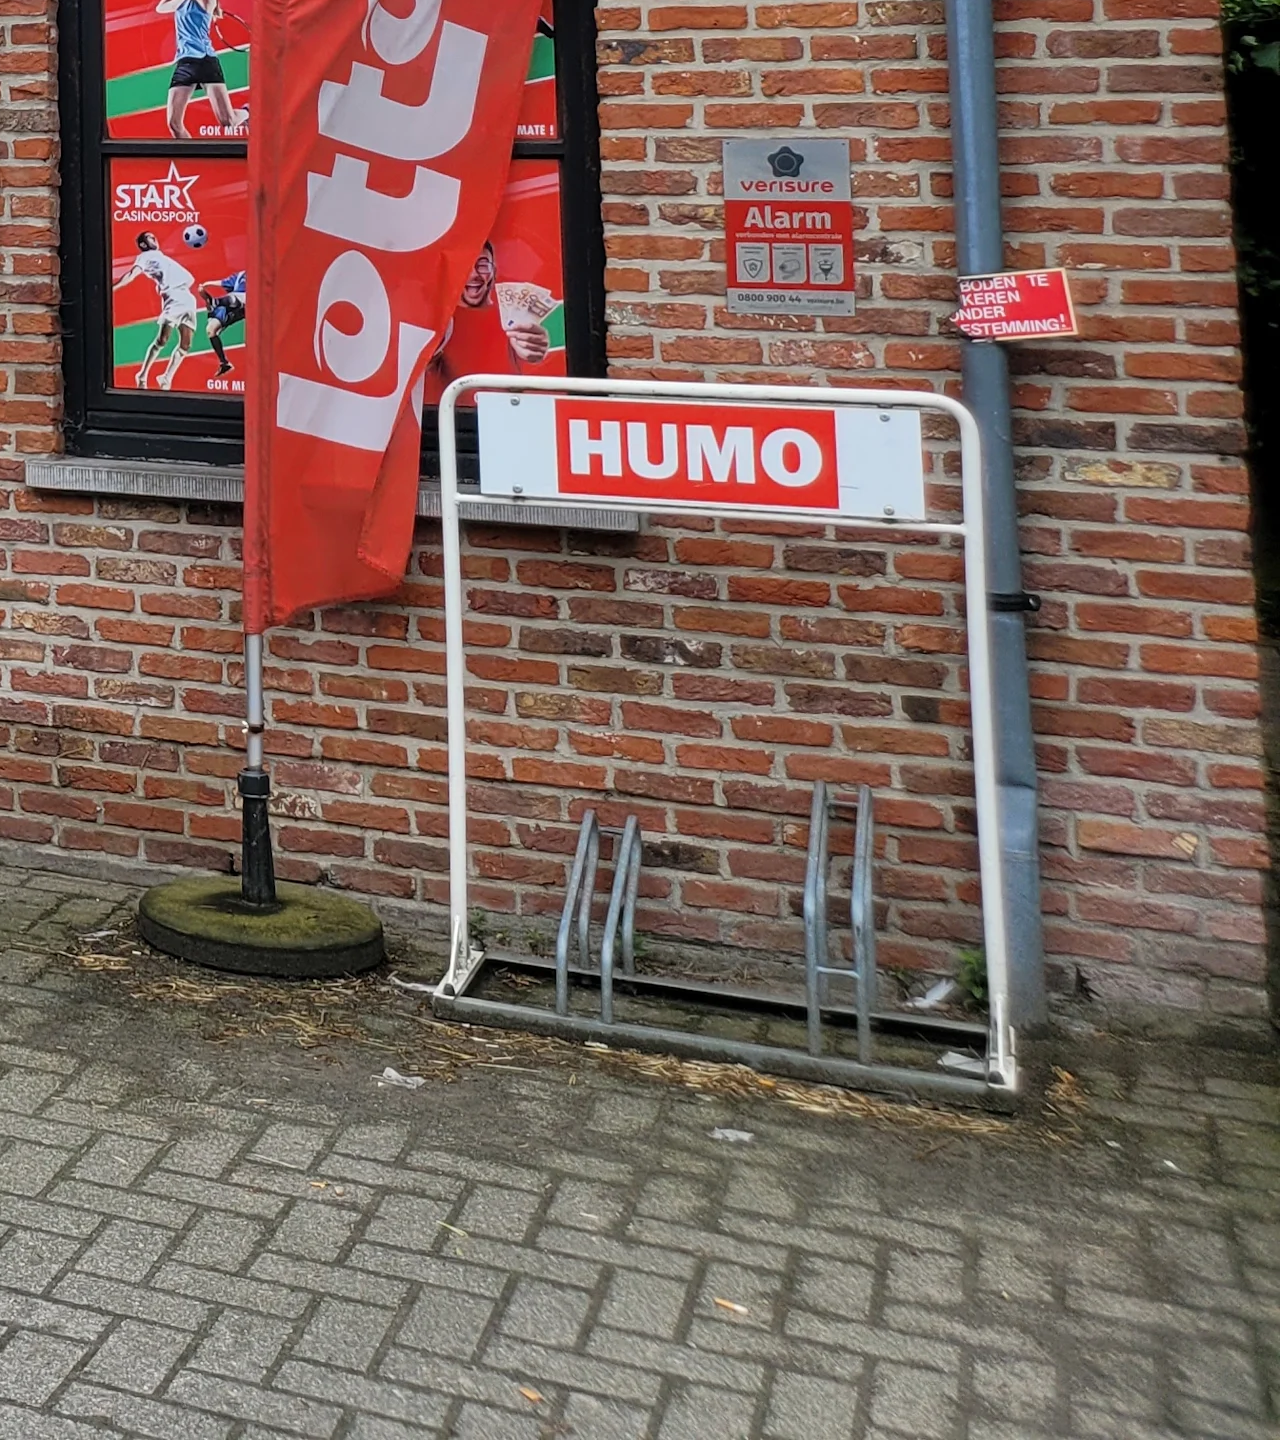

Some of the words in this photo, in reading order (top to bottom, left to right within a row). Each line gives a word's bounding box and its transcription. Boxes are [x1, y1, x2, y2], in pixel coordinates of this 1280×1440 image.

[199, 126, 221, 137] GOK
[517, 124, 545, 136] MATE
[740, 180, 834, 195] verisure
[115, 182, 195, 210] STAR
[113, 210, 201, 224] CASINOSPORT
[744, 206, 832, 230] Alarm
[960, 276, 1017, 293] BODEN
[1026, 274, 1050, 287] TE
[737, 293, 764, 302] 0800
[766, 294, 786, 302] 900
[788, 295, 802, 303] 44
[962, 291, 1021, 307] KEREN
[949, 306, 1006, 322] ONDER
[960, 314, 1067, 336] ESTEMMING!
[207, 378, 229, 391] GOK
[231, 378, 245, 391] ME
[568, 419, 824, 488] HUMO
